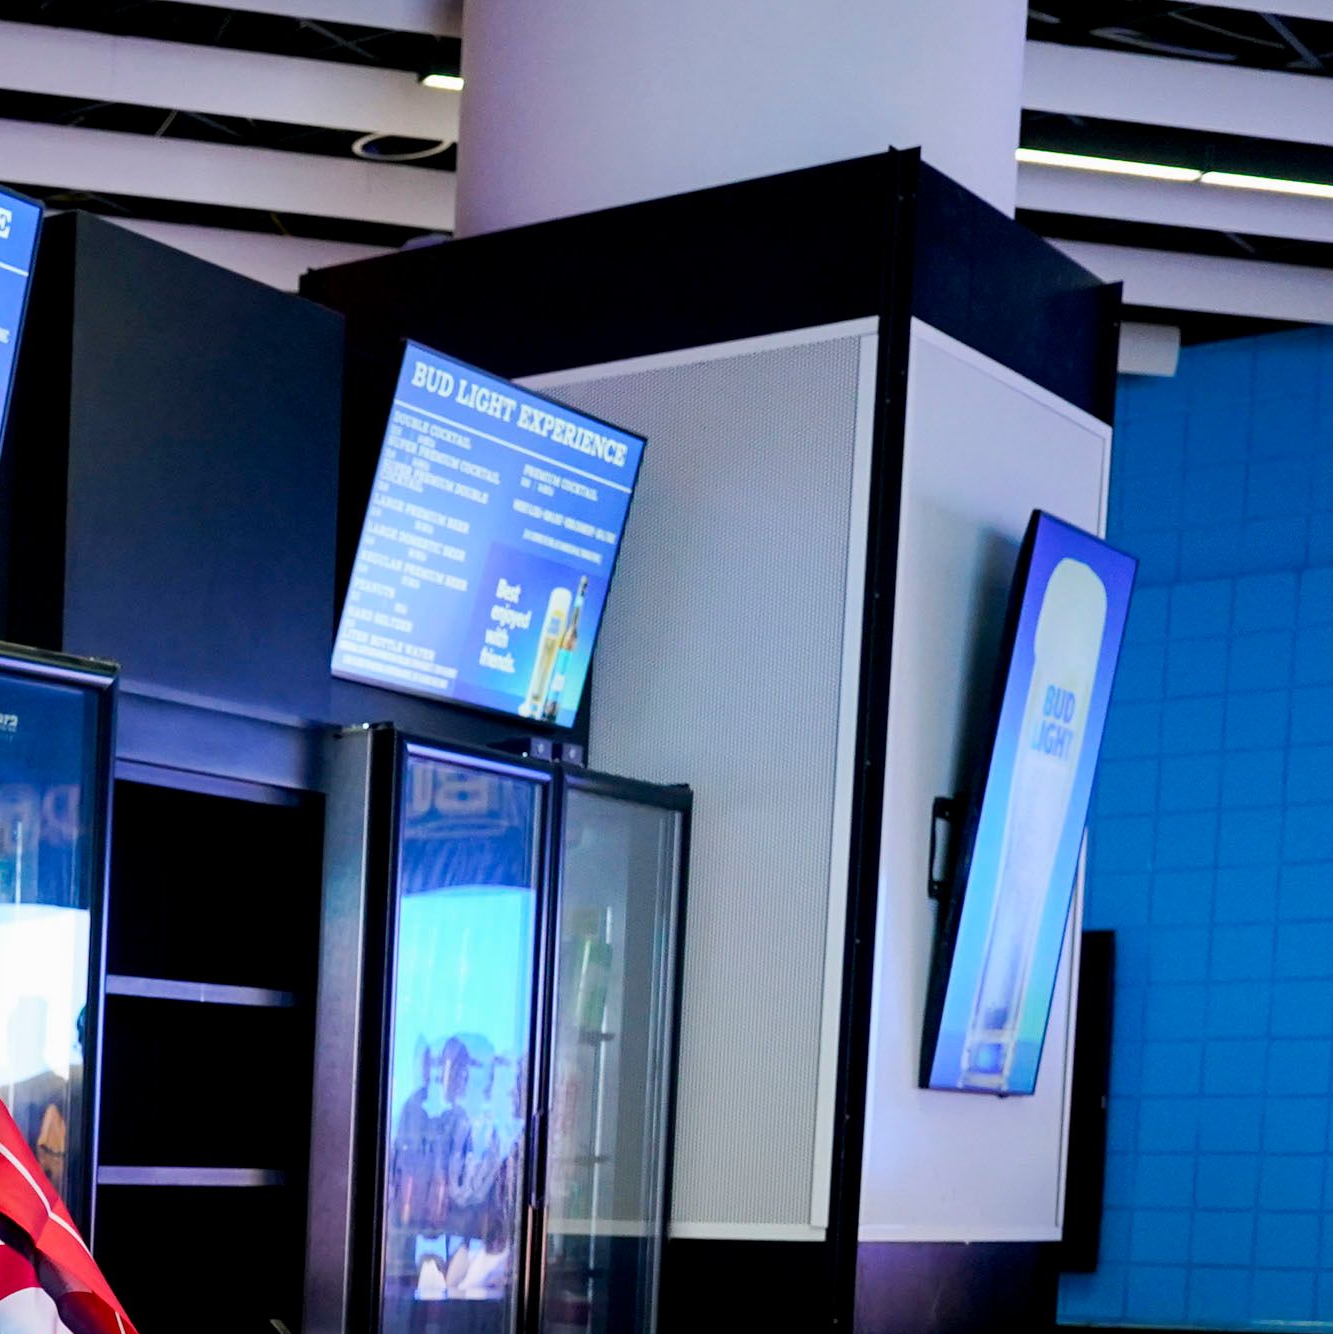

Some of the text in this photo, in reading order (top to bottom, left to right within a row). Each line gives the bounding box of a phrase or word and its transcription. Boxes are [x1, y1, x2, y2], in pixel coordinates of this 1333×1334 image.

[412, 362, 627, 465] BUD LIGHT EXPERIENCE
[1044, 685, 1076, 724] BUD
[1031, 720, 1075, 760] LIGHT
